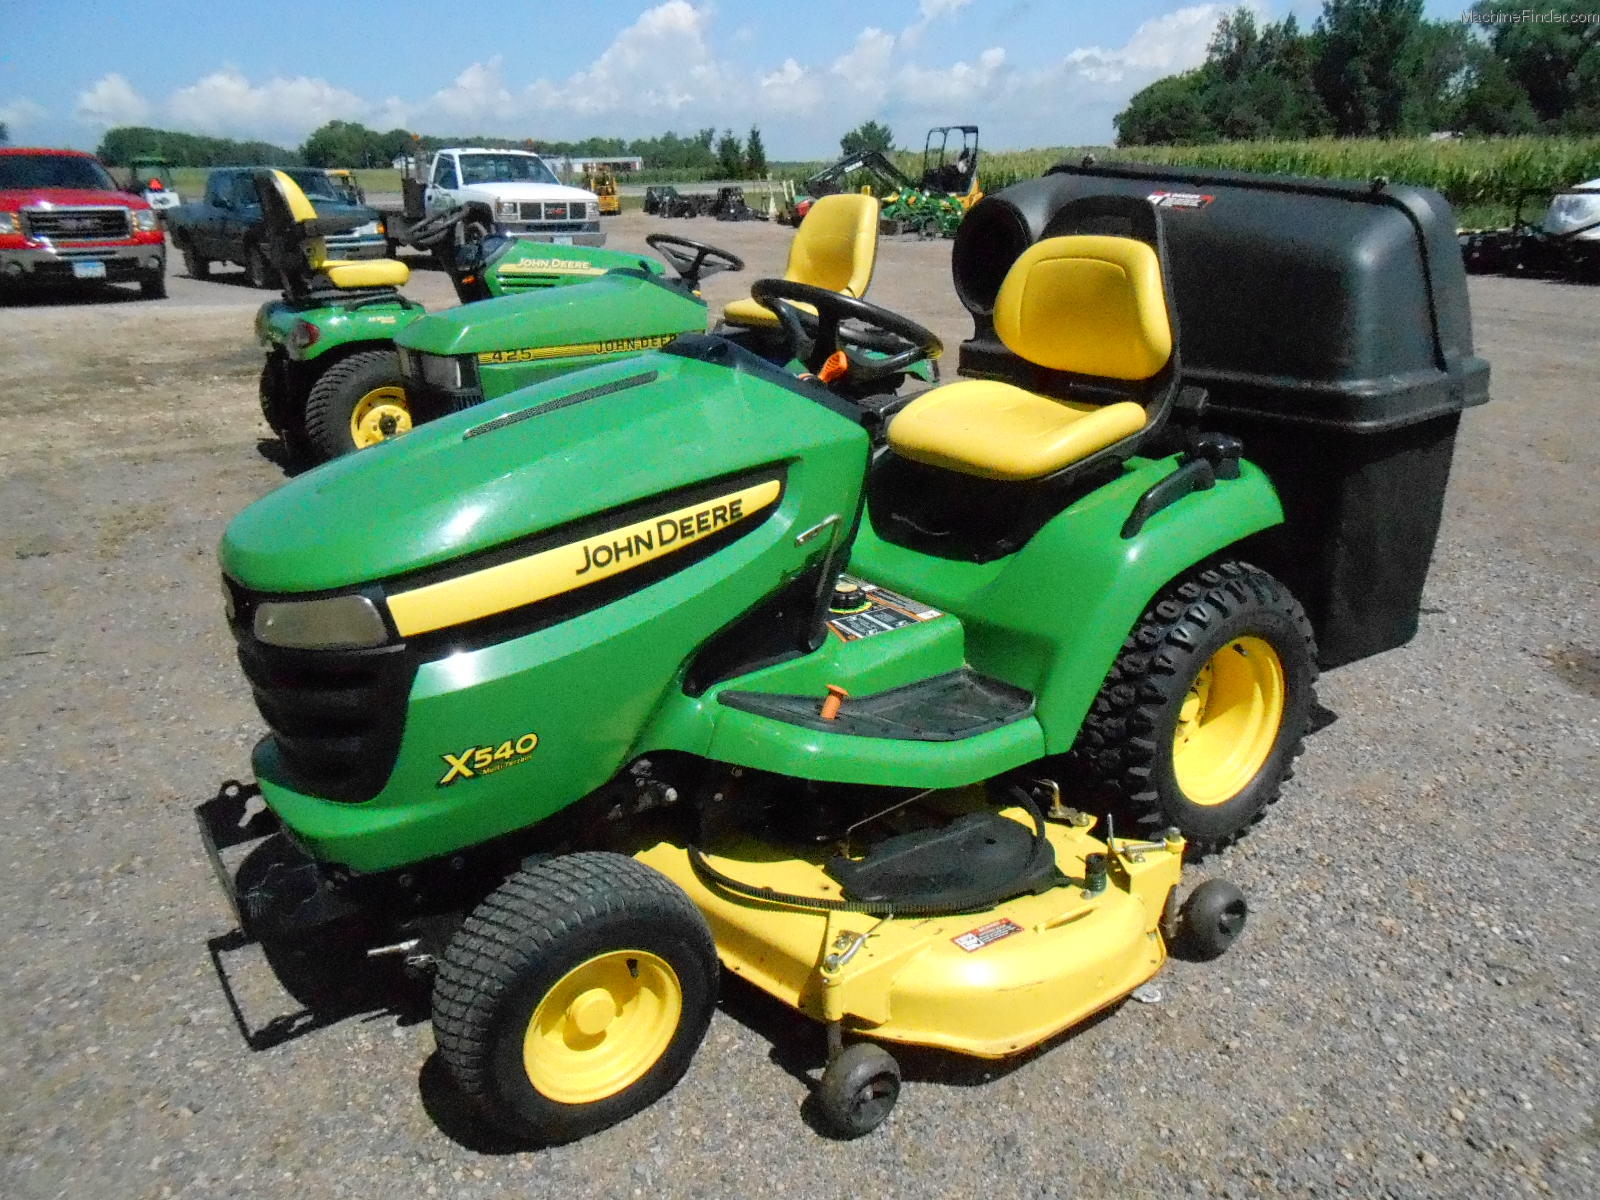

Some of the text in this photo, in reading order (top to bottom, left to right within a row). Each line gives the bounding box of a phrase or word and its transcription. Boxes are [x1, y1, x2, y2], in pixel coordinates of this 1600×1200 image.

[517, 258, 591, 269] JOHN DEERE
[595, 339, 636, 354] JOHN
[492, 348, 532, 361] 425
[575, 498, 743, 575] JOHN DEERE
[439, 732, 539, 785] X540
